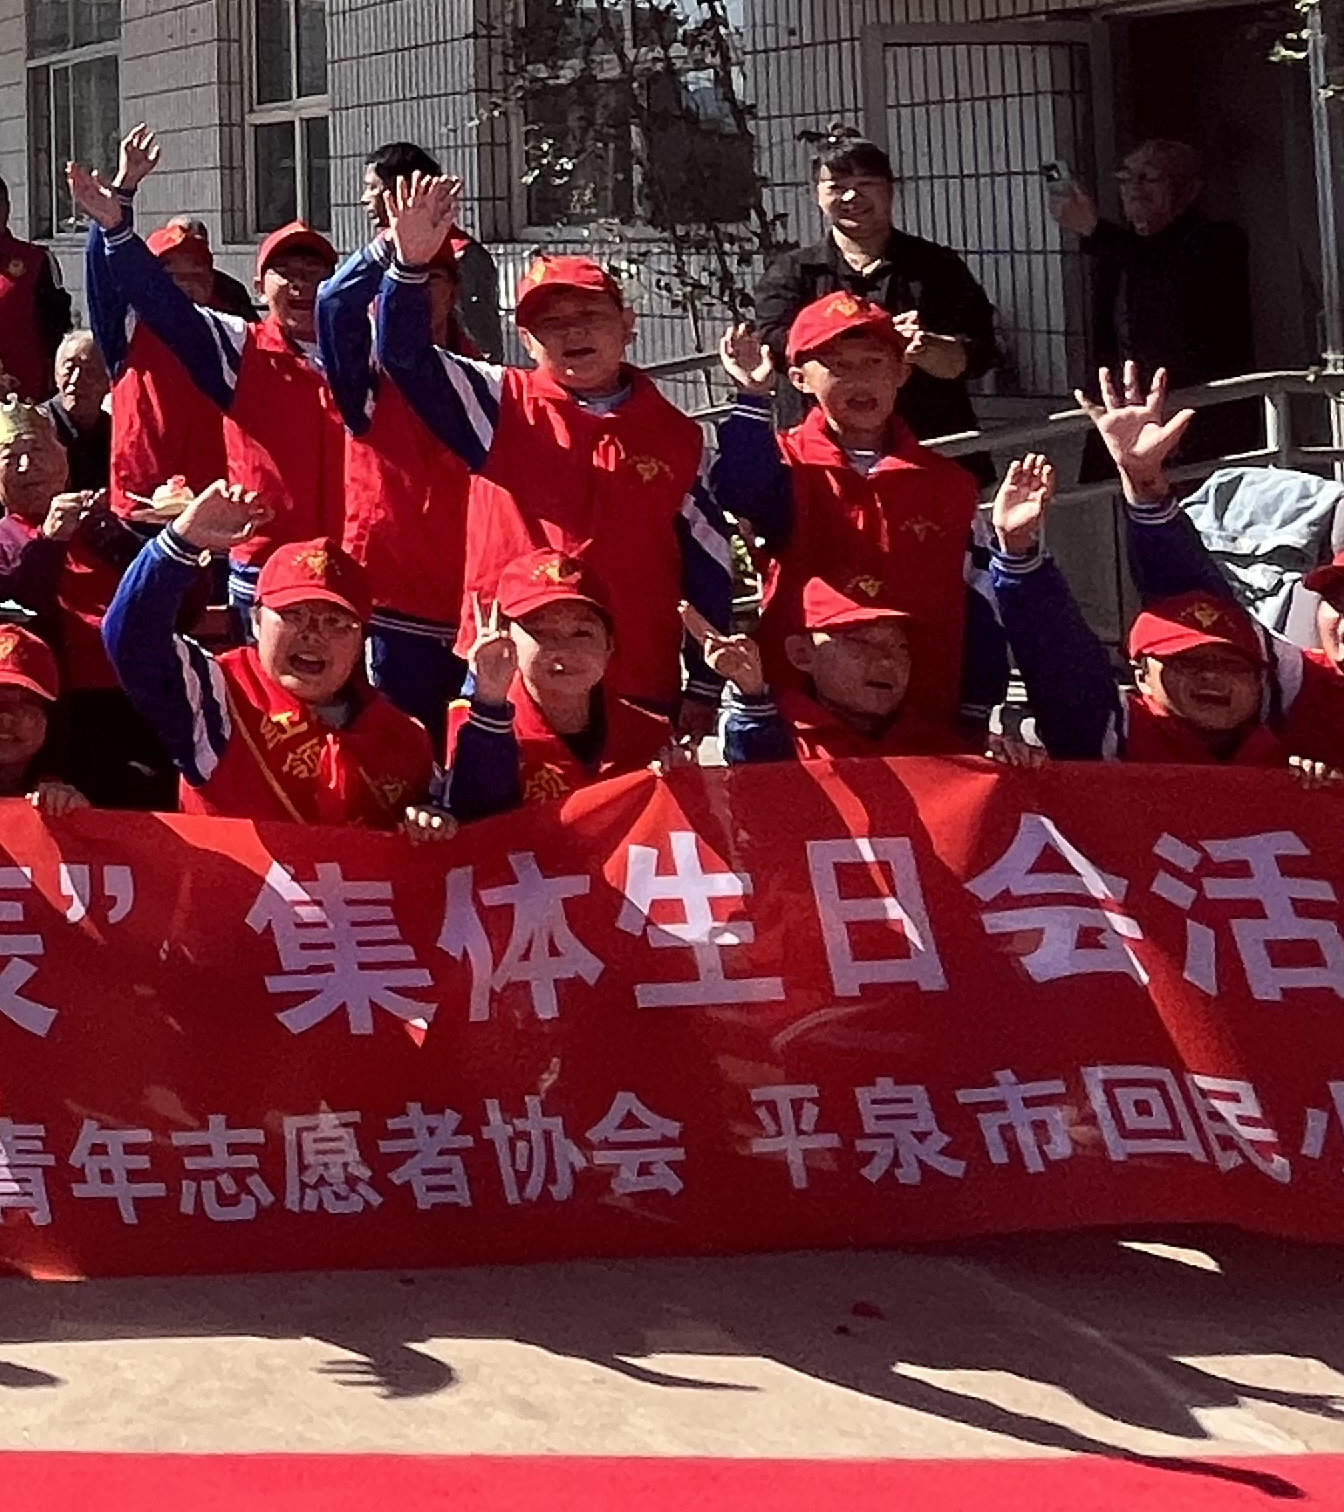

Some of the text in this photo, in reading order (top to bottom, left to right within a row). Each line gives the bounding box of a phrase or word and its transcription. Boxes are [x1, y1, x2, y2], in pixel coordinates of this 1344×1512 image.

[244, 812, 1344, 1036] 集体生日会活
